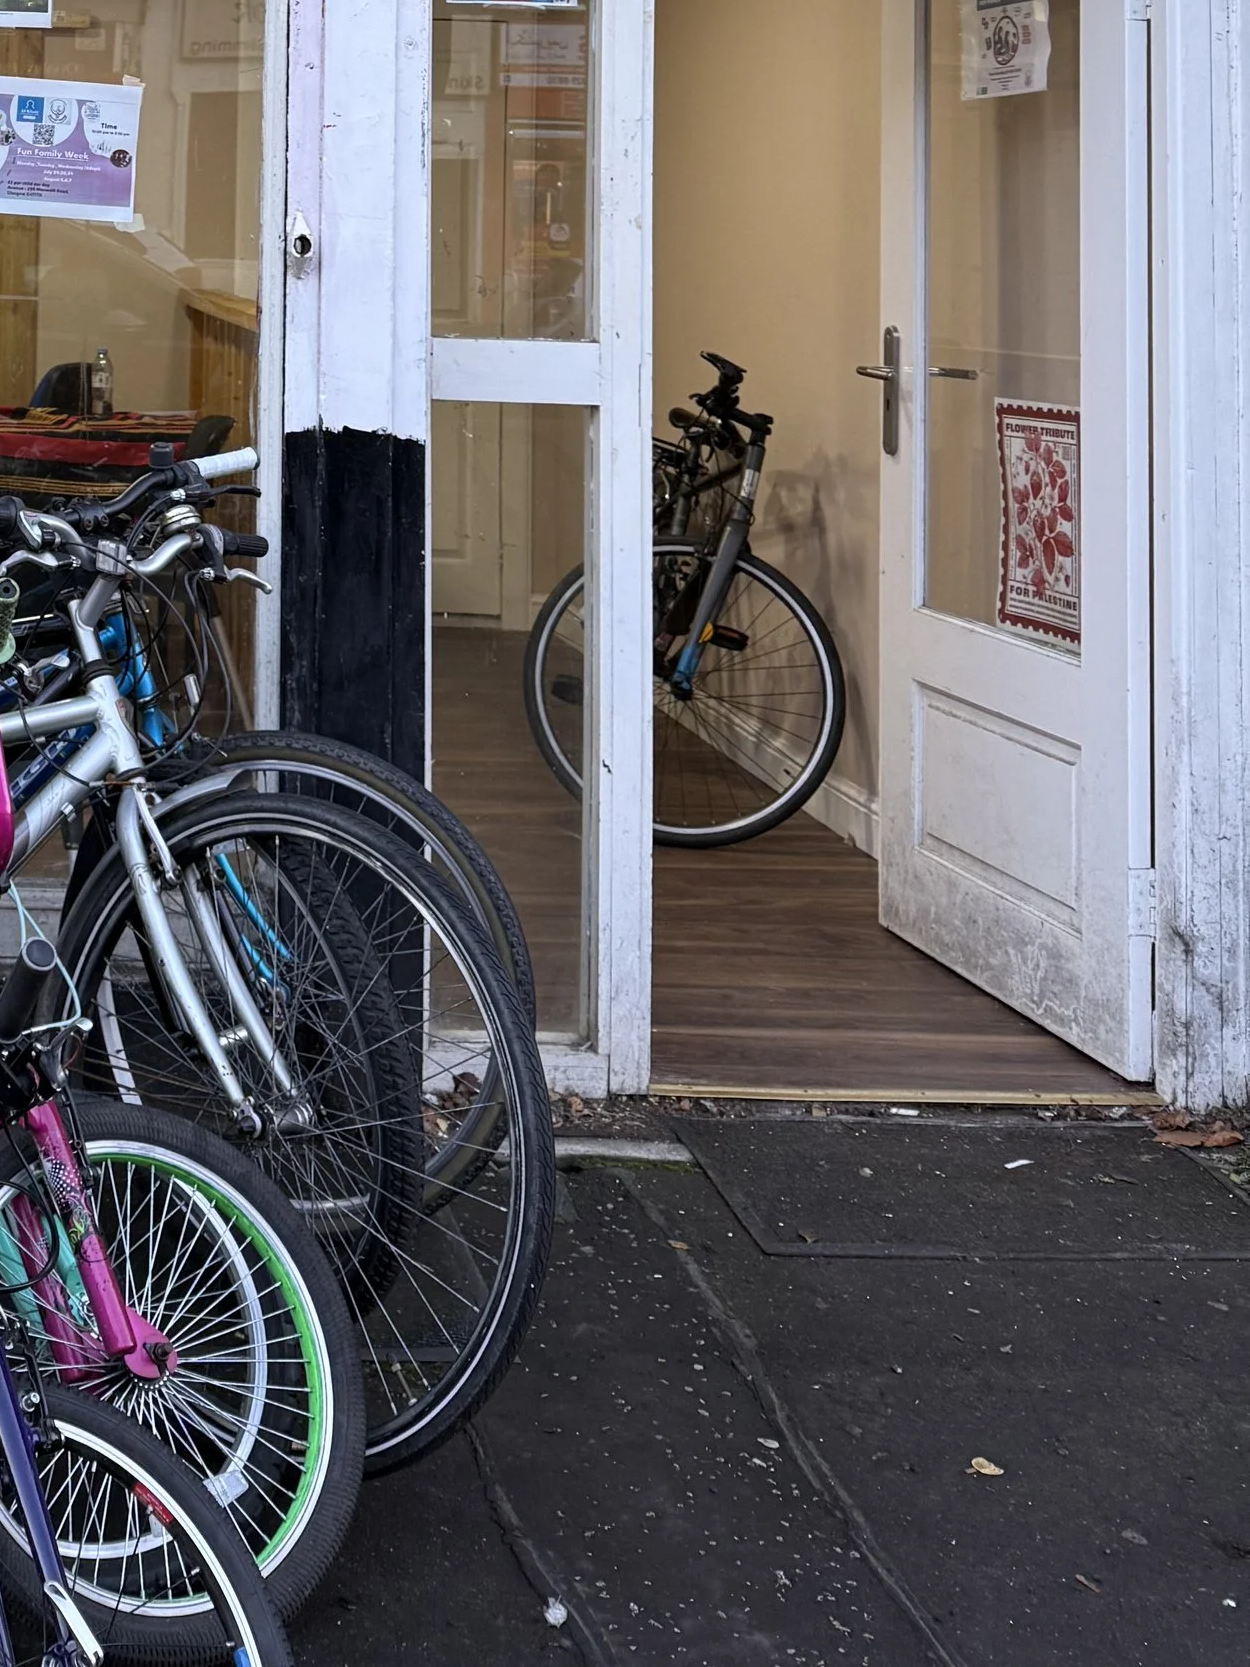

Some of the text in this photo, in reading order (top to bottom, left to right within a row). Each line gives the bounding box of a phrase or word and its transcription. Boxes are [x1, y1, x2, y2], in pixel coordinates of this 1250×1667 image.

[16, 147, 90, 160] Fun Family Week
[1005, 422, 1076, 440] FLOWER TRIBUTE
[1009, 584, 1030, 599] FOR
[1031, 589, 1078, 612] PALESTINE
